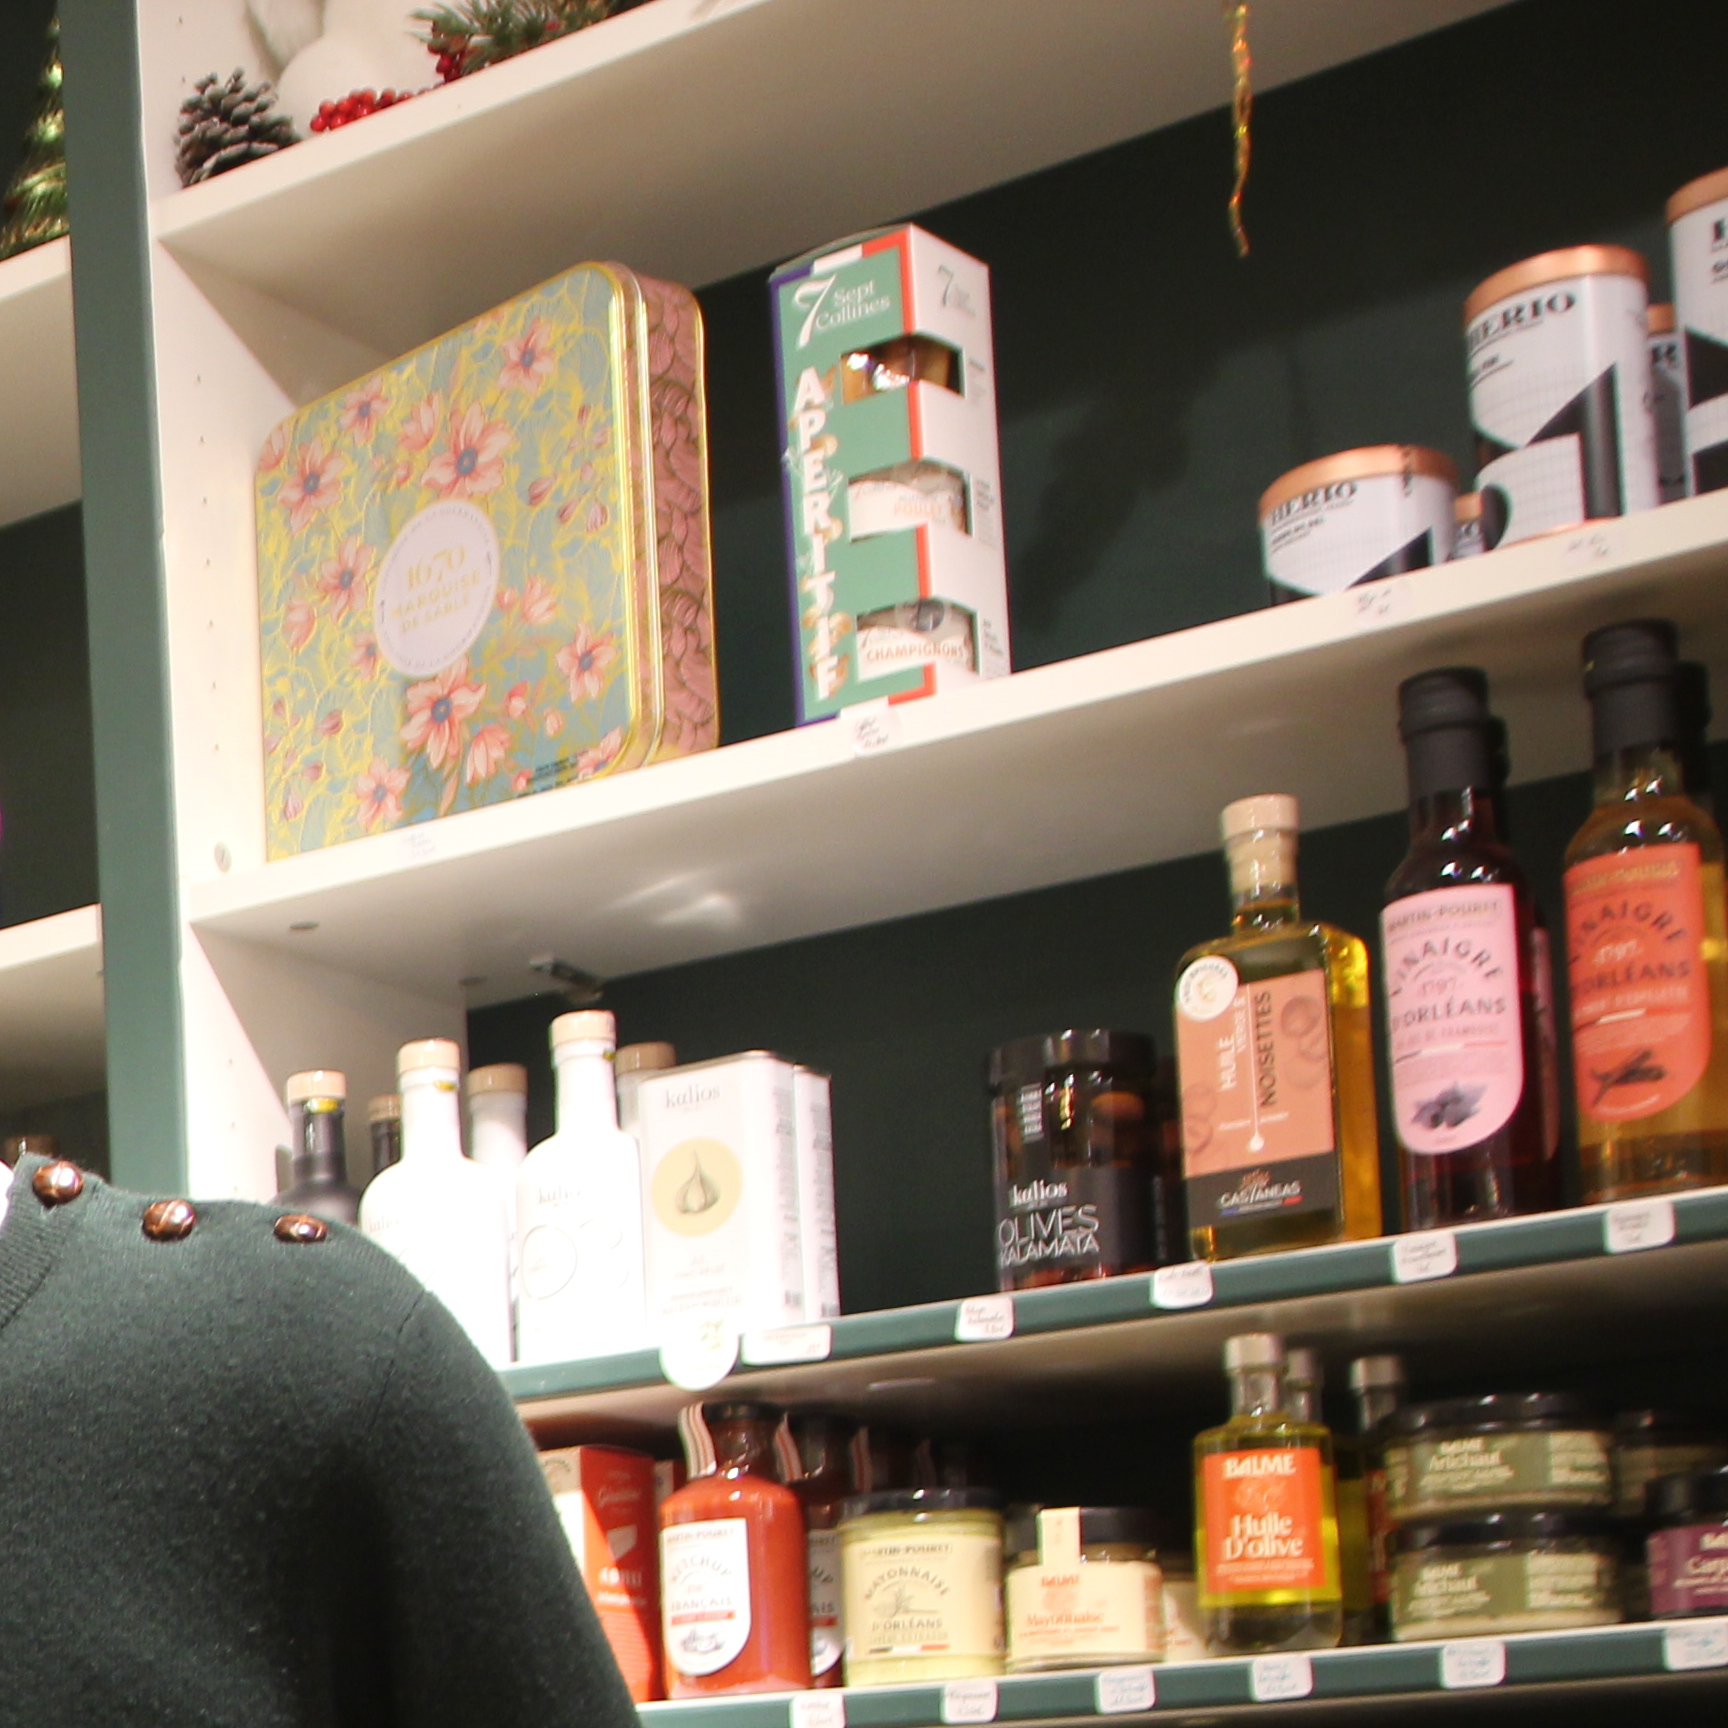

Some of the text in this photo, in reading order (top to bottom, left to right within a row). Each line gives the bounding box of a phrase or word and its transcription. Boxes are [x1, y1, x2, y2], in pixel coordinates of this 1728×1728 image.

[834, 280, 876, 305] Sept
[815, 294, 890, 329] Collines
[865, 637, 966, 660] CHAMPIGNONS
[1255, 990, 1278, 1107] NOISETTES
[997, 1204, 1101, 1247] OLIVES
[1000, 1234, 1101, 1269] KALAMATA
[1223, 1453, 1297, 1480] BALME
[1232, 1514, 1294, 1538] Huile
[1225, 1532, 1305, 1561] D'olive
[864, 1566, 951, 1601] MAYONNAISE
